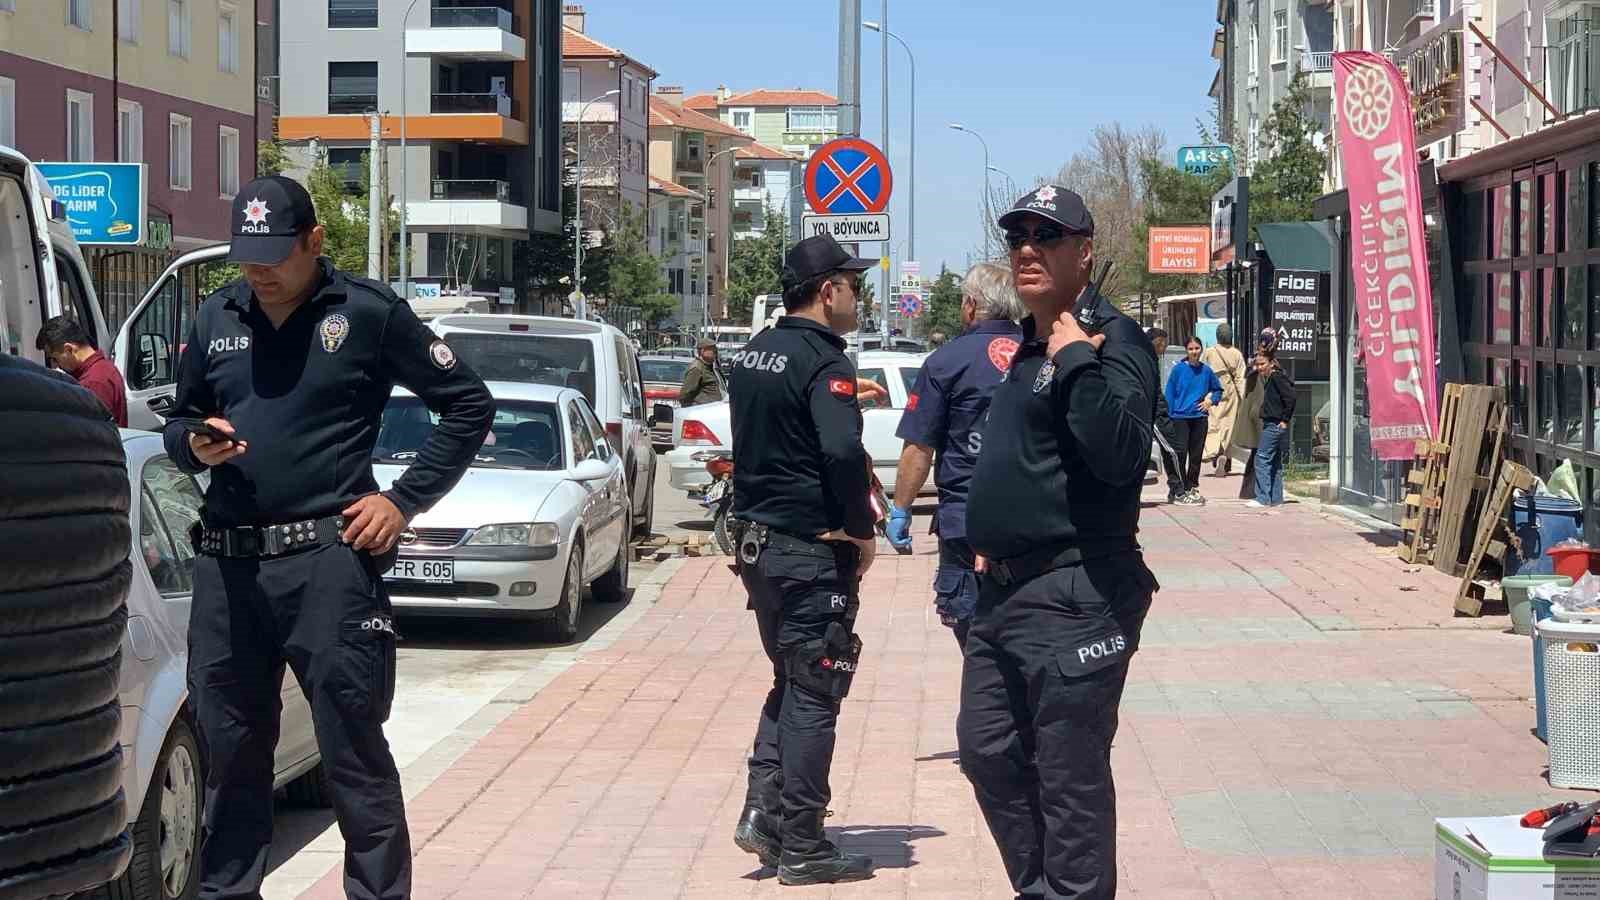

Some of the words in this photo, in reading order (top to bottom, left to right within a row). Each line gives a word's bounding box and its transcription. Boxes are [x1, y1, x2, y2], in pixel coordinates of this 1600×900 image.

[812, 222, 831, 235] YOL
[834, 221, 880, 235] BOYUNCA
[1278, 275, 1315, 290] FİDE
[1291, 326, 1313, 338] AZİZ
[423, 561, 451, 578] 605
